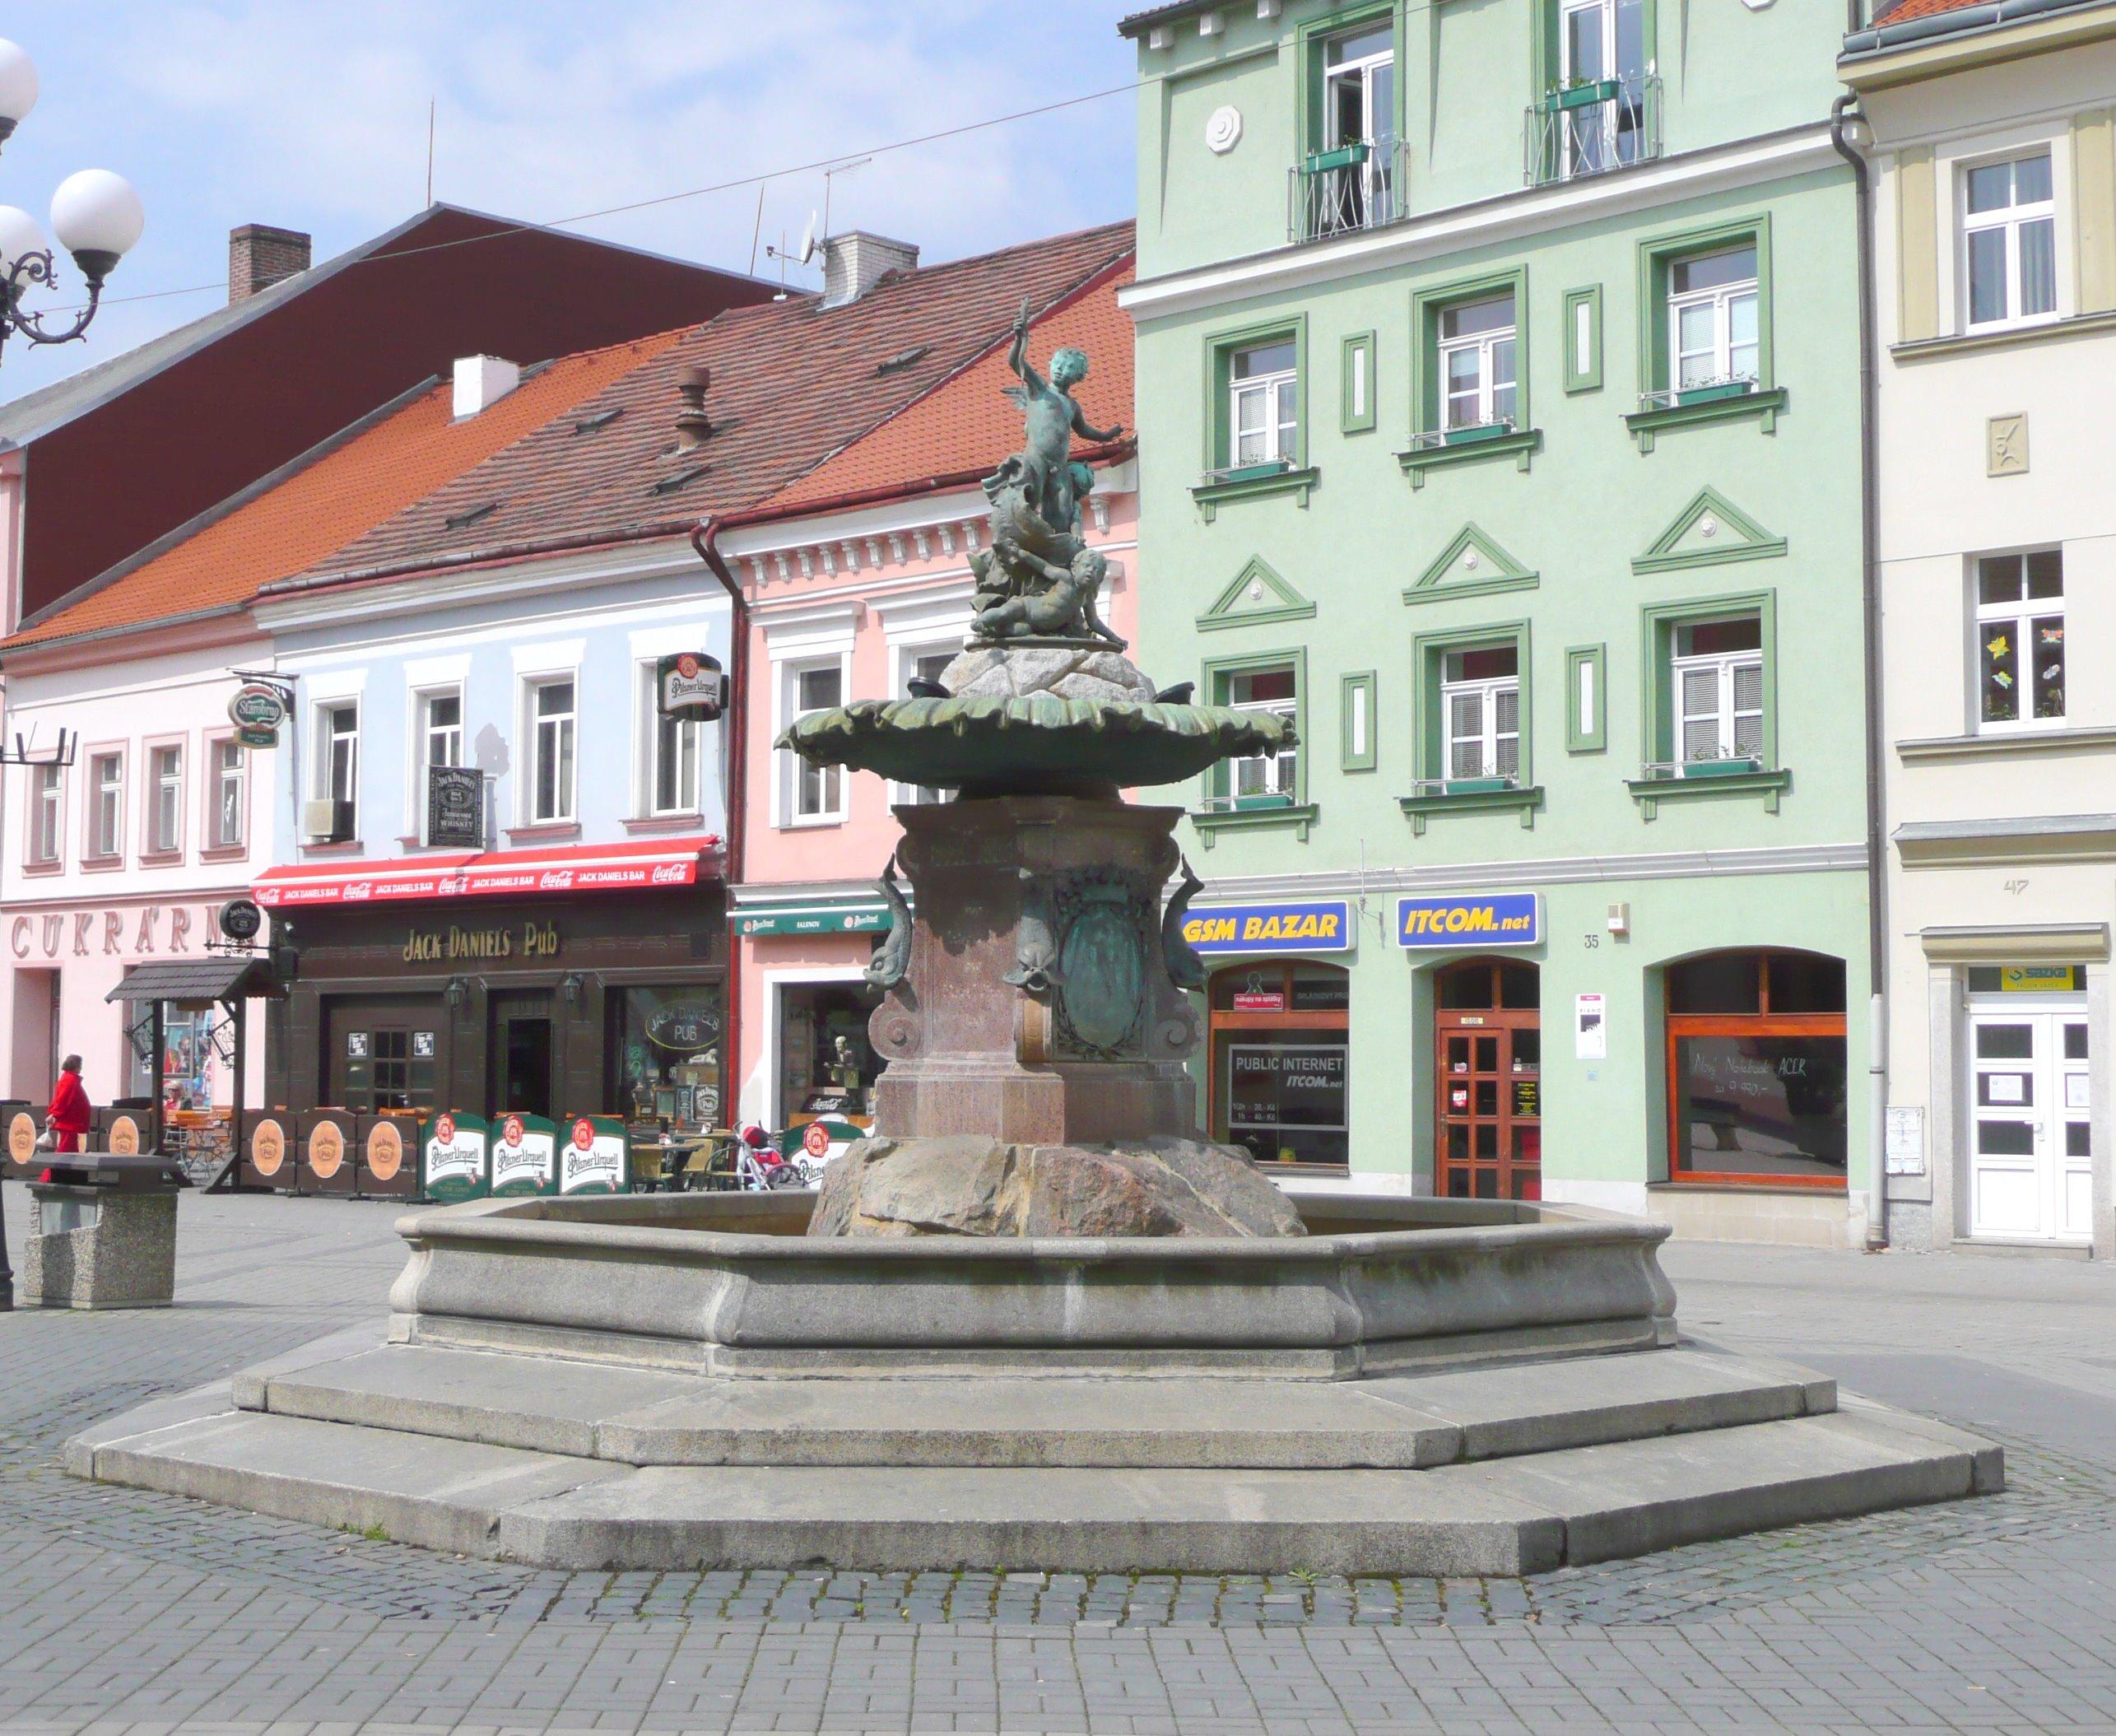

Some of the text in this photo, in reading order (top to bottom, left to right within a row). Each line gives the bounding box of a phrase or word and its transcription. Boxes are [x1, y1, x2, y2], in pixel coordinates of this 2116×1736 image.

[672, 677, 718, 699] Pilsner Urquell
[440, 819, 473, 828] WHISKEY
[420, 882, 434, 891] BAR
[472, 878, 490, 888] JACK
[519, 876, 535, 885] BAR
[578, 873, 598, 882] JACK
[630, 870, 645, 881] BAR
[2003, 878, 2030, 896] 47
[11, 905, 258, 958] CUKRÁRN
[1183, 914, 1339, 942] GSM BAZAR
[402, 929, 442, 961] JACK
[523, 919, 557, 956] Pub
[1584, 934, 1599, 948] 35
[674, 1025, 697, 1041] PUB
[1236, 1057, 1343, 1071] PUBLIC INTERNET
[1778, 1057, 1807, 1077] ACER
[431, 1145, 479, 1171] Pilsner Urquell
[498, 1147, 546, 1175] Pilsner Urquell
[568, 1151, 619, 1179] Pilsner Urquell
